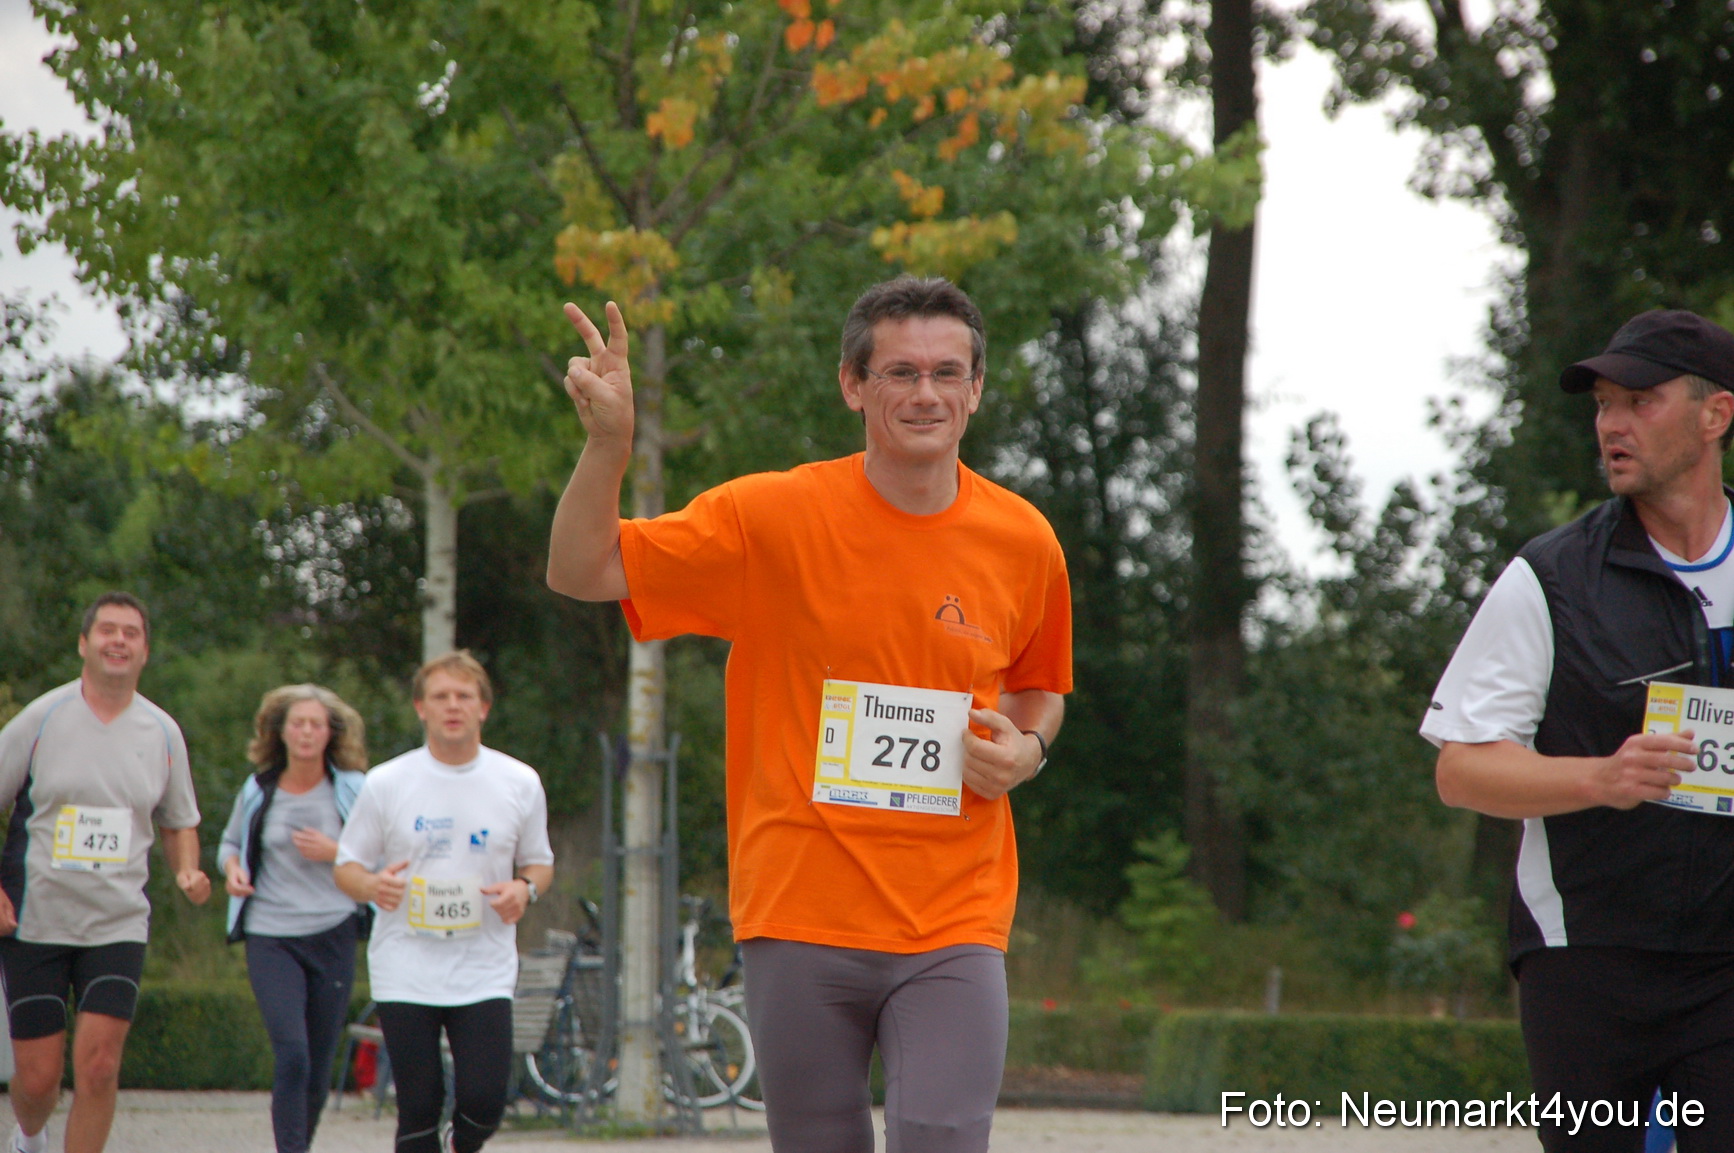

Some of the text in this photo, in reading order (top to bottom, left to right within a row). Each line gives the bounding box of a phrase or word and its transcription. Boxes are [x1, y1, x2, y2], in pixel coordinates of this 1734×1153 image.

[863, 694, 935, 724] Thomas
[825, 727, 835, 744] D
[871, 735, 942, 772] 278
[906, 793, 958, 808] PFLEIDERER
[84, 833, 119, 852] 473
[435, 901, 471, 919] 465
